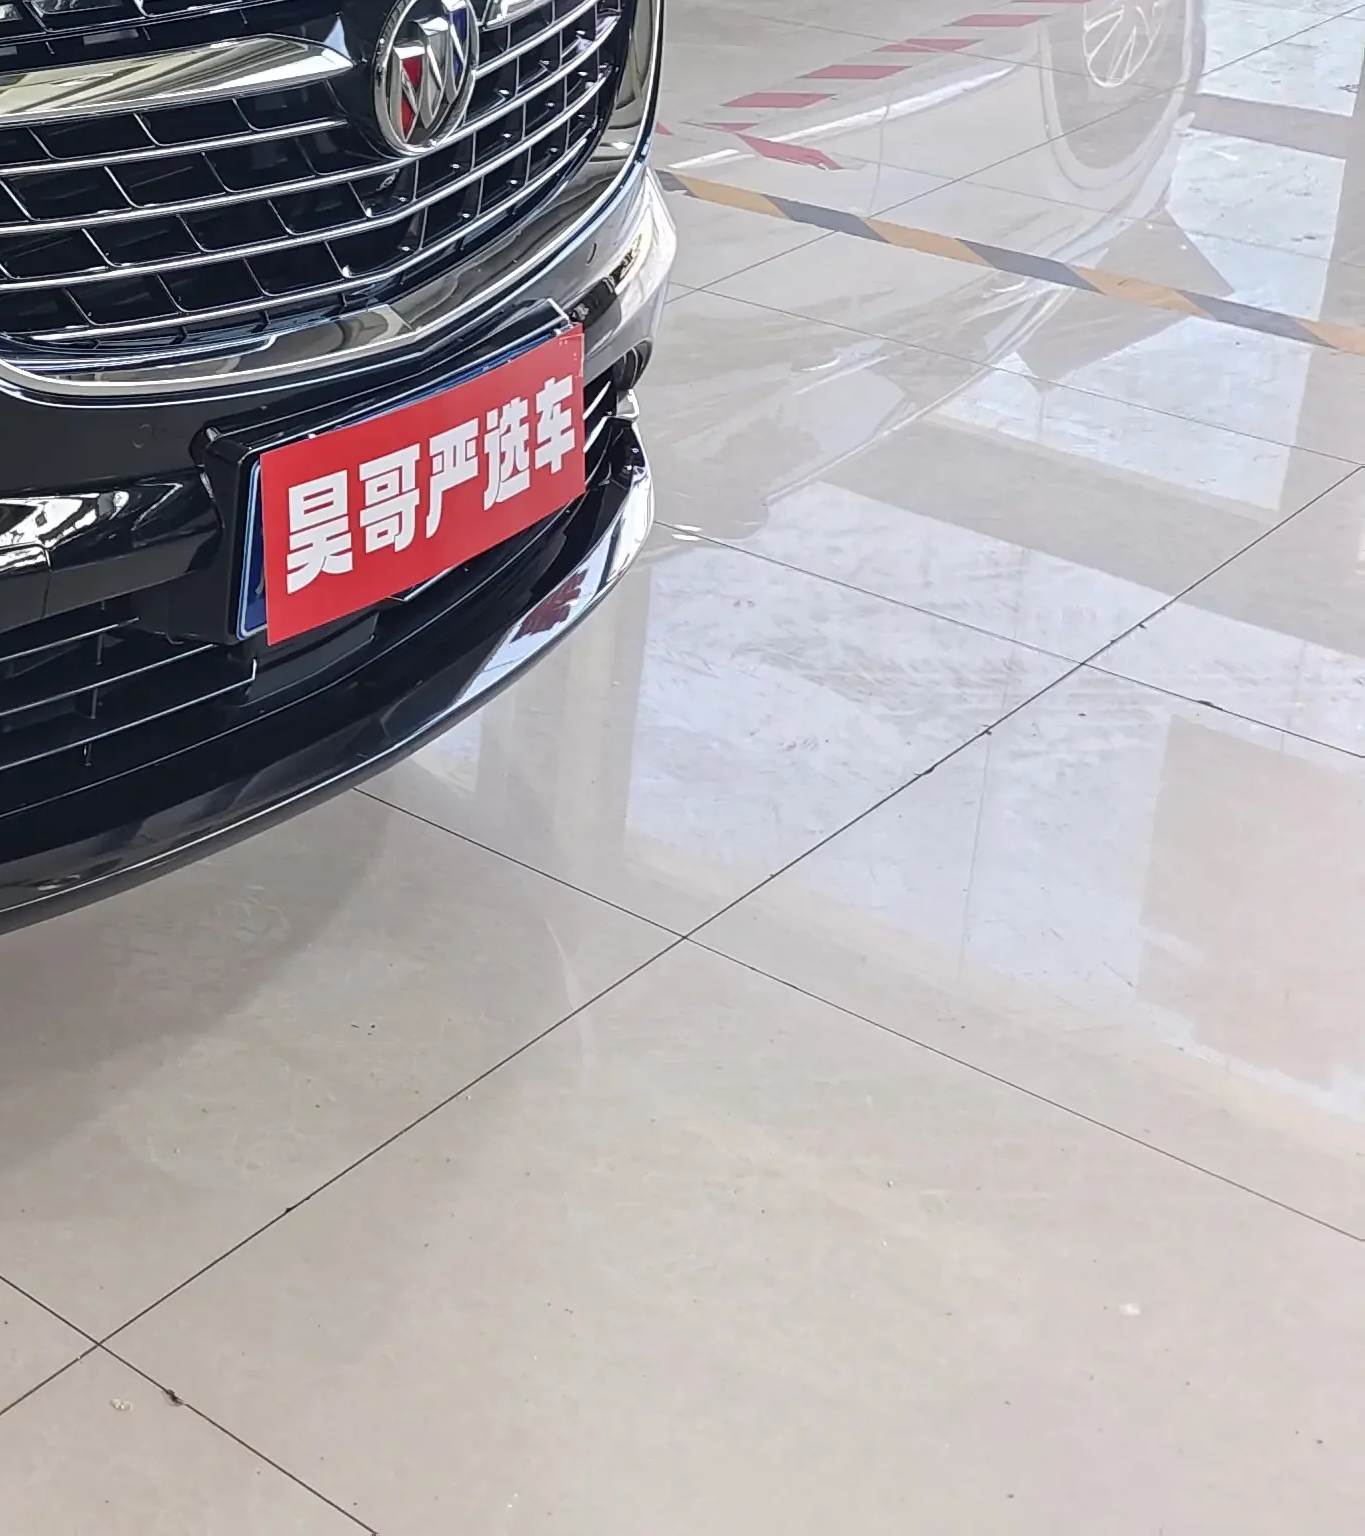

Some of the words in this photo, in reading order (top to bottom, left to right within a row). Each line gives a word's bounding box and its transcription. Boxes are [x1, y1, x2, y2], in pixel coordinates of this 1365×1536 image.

[285, 374, 576, 596] 昊哥严选车
